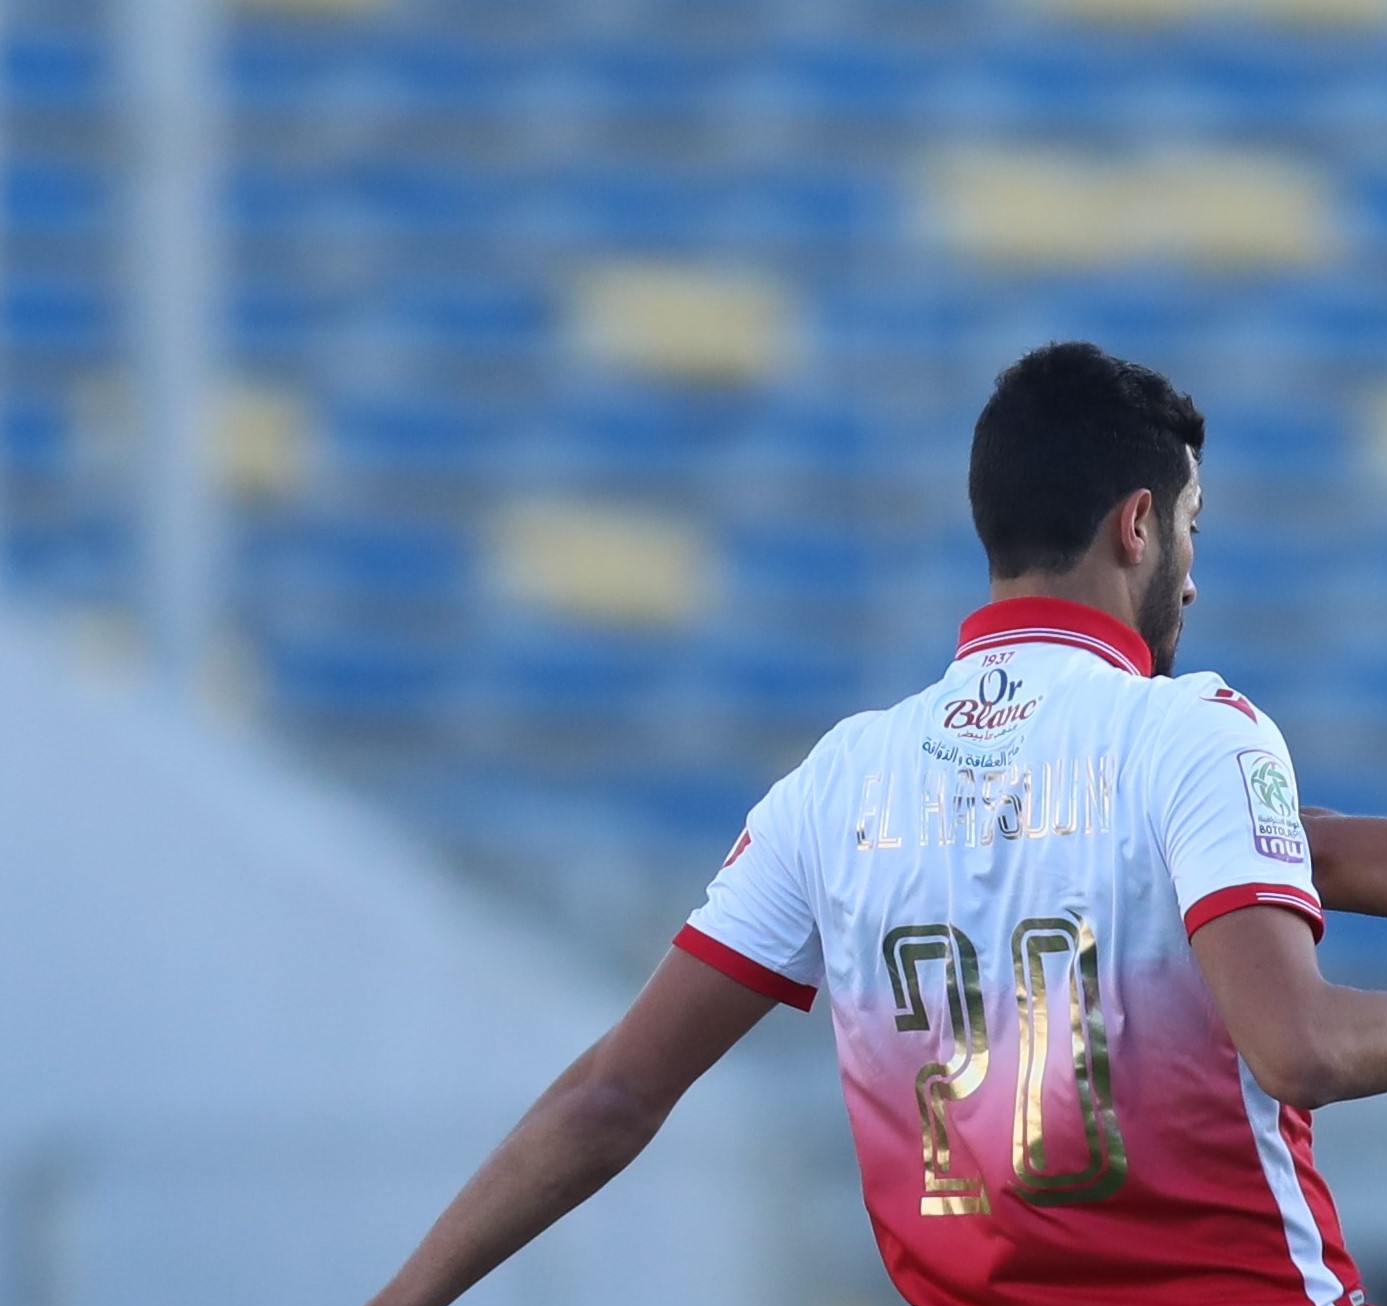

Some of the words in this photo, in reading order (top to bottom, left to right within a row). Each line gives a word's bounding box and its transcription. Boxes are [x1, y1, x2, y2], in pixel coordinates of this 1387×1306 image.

[981, 650, 1016, 668] 1937
[978, 667, 1023, 706] Or
[943, 698, 1037, 730] Blanc
[882, 907, 1129, 1216] 20
